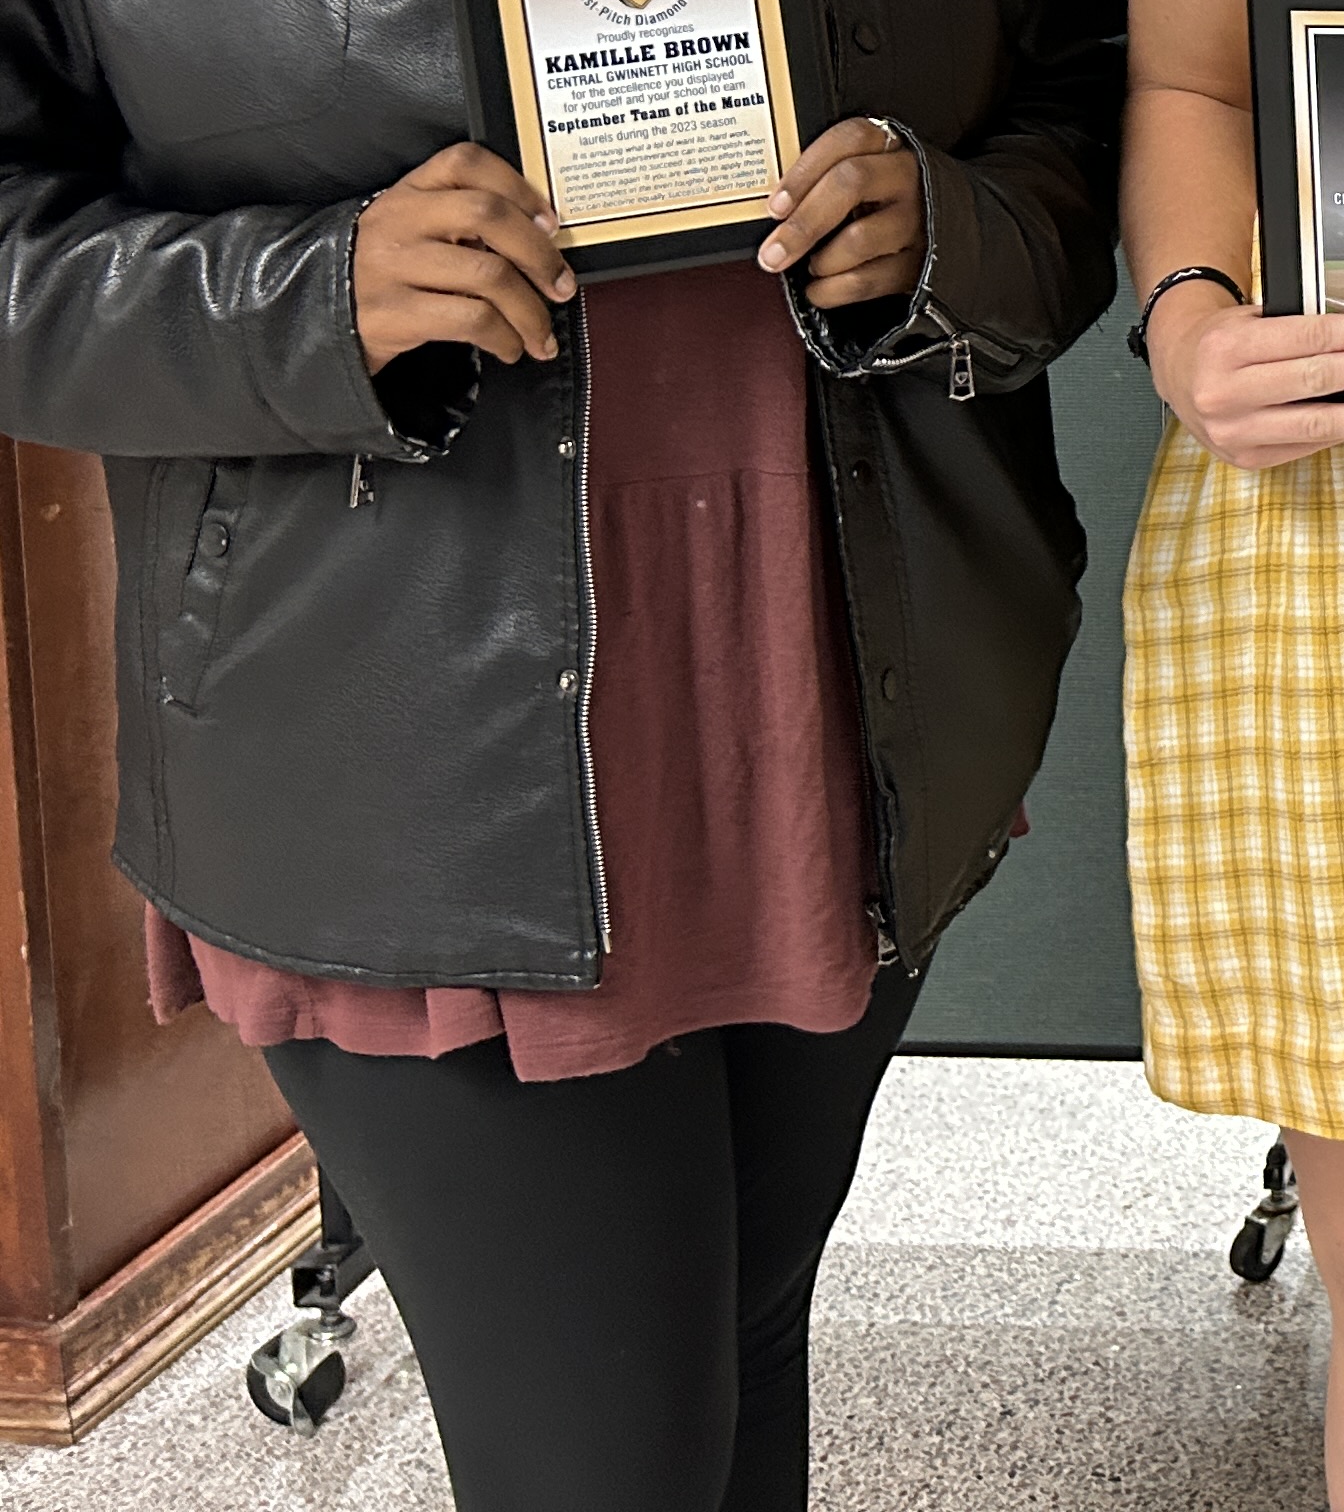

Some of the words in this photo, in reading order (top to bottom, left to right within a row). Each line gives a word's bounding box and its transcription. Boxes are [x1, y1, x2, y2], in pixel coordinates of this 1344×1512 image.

[596, 29, 636, 44] Proudly
[638, 23, 694, 39] recognizes
[544, 44, 656, 73] KAMILLE
[663, 31, 750, 58] BROWN
[547, 72, 602, 89] CENTRAL
[605, 63, 669, 82] GWINNETT
[672, 59, 701, 73] HIGH
[704, 53, 753, 69] SCHOOL
[571, 89, 586, 100] for
[589, 87, 605, 97] the
[607, 79, 662, 95] excellence
[664, 78, 684, 90] you
[686, 69, 734, 87] displayed
[563, 102, 578, 112] for
[580, 96, 623, 112] yourself
[625, 93, 644, 104] and
[647, 91, 671, 103] your
[673, 85, 707, 98] school
[710, 83, 720, 93] to
[723, 81, 745, 91] earn
[546, 110, 626, 135] September
[630, 105, 670, 121] Team
[674, 102, 689, 115] of
[693, 98, 716, 112] the
[721, 92, 764, 109] Month
[579, 132, 613, 145] laurels
[616, 127, 649, 142] during
[651, 124, 667, 135] the
[669, 120, 697, 133] 2023
